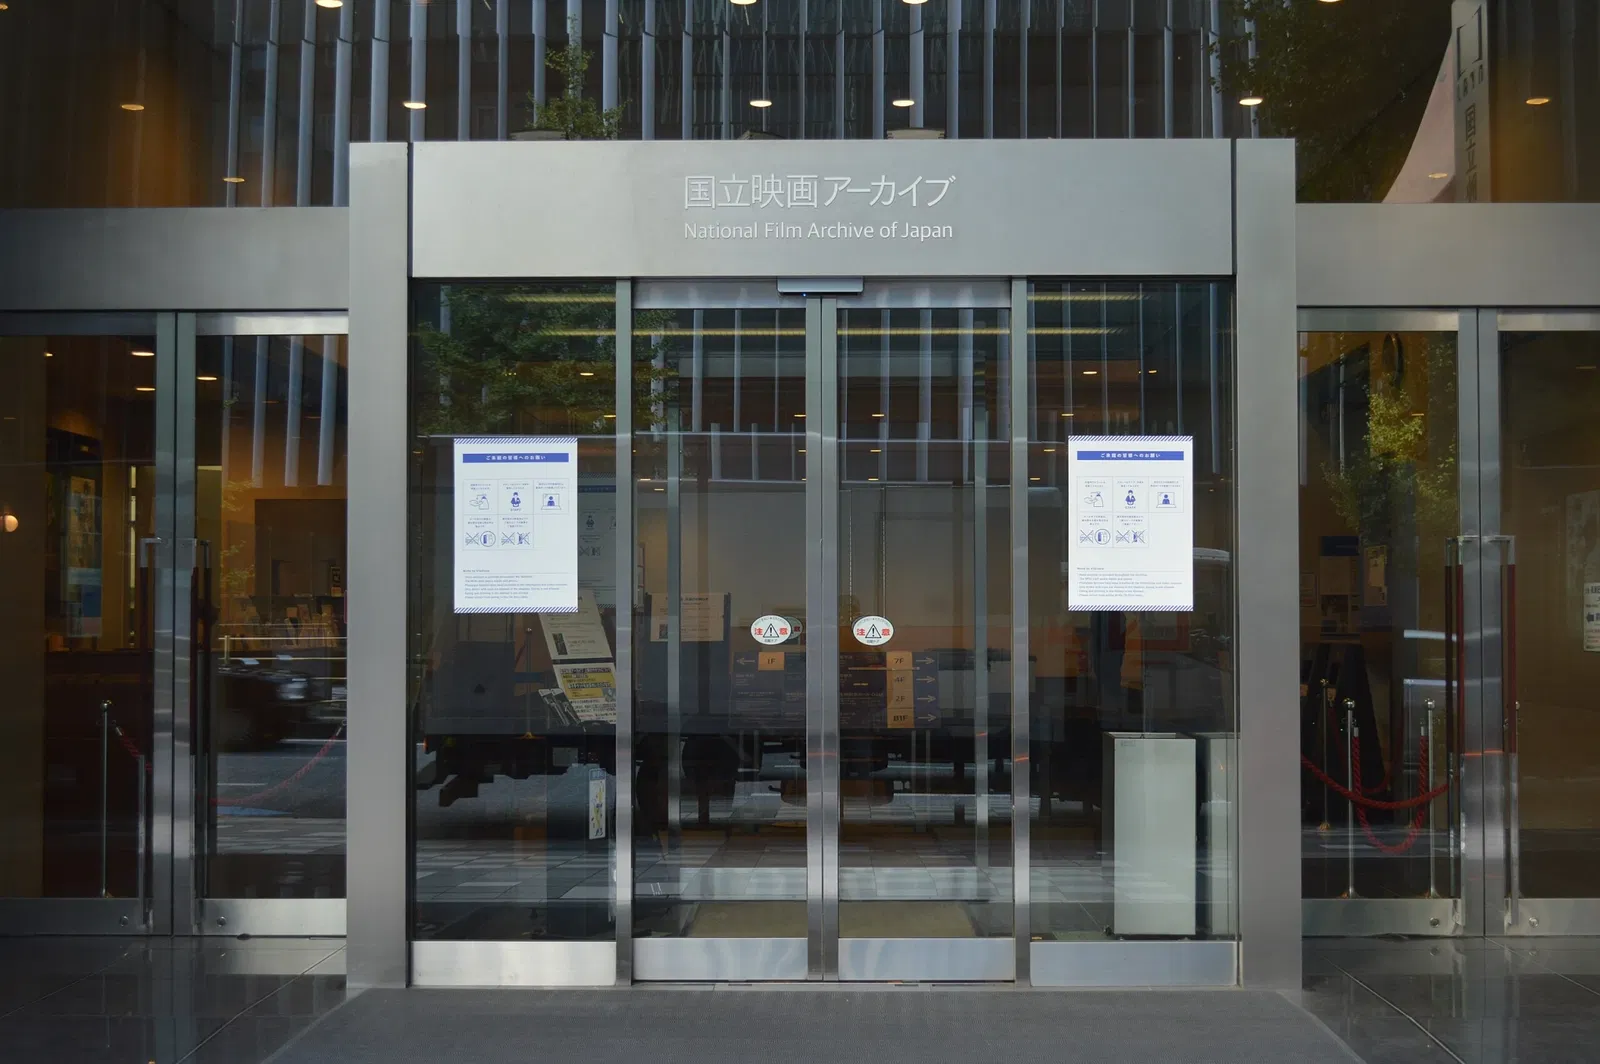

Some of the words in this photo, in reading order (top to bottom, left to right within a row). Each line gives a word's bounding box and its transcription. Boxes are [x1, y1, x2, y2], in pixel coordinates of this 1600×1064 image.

[684, 173, 957, 210] 国立映画アーカイブ
[684, 221, 758, 239] National
[764, 221, 802, 239] Film
[807, 221, 874, 239] Archive
[879, 221, 898, 239] of
[900, 222, 953, 243] Japan
